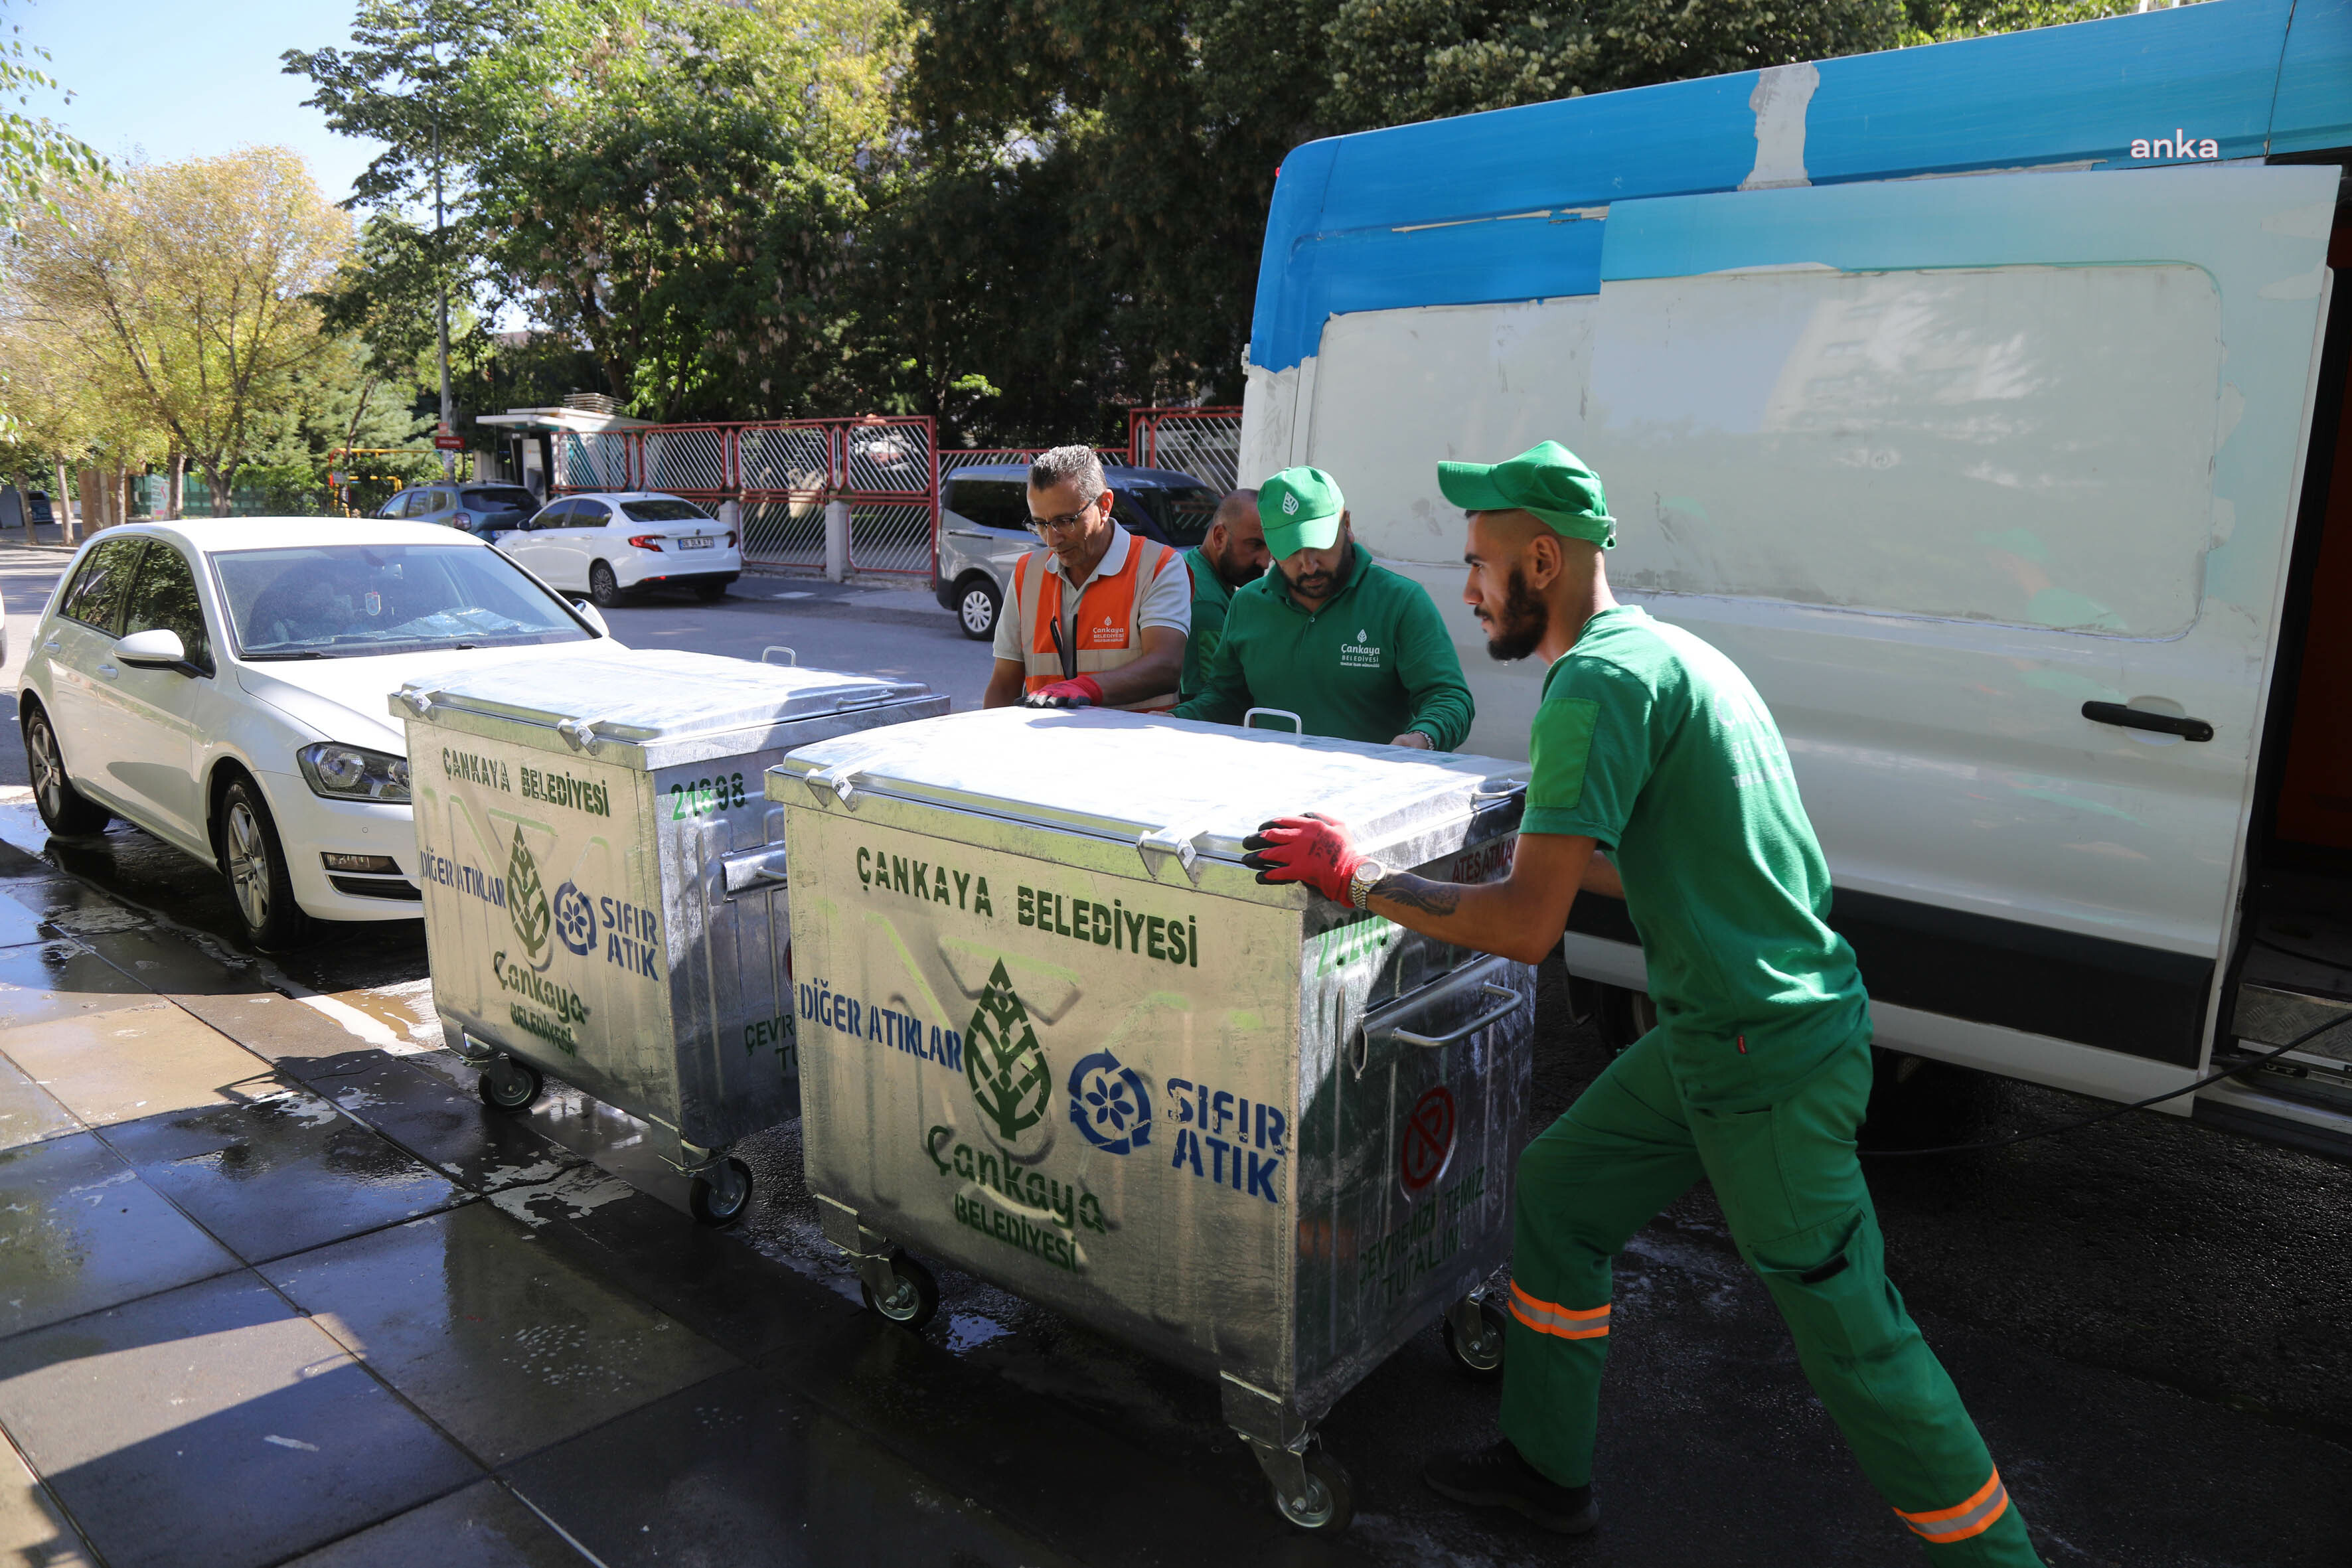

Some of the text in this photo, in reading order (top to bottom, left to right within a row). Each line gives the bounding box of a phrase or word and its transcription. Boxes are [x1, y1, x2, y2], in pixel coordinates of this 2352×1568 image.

[1341, 643, 1380, 656] Çankaya
[443, 747, 610, 817] ÇANKAYA BELEDİYESİ
[670, 773, 745, 821] 21898
[420, 845, 507, 909] DİĞER ATIKLAR
[856, 846, 1198, 968] ÇANKAYA BELEDİYESİ
[600, 896, 659, 946] SIFIR
[493, 951, 586, 1025] Çankaya
[607, 933, 659, 982] ATIK
[510, 1001, 576, 1058] BELEDİYESİ
[801, 977, 963, 1073] DİĞER ATIKLAR
[1167, 1077, 1287, 1156] SIFIR
[927, 1125, 1105, 1234] Çankaya
[1172, 1129, 1279, 1204] ATIK
[955, 1194, 1077, 1273] BELEDİYESİ
